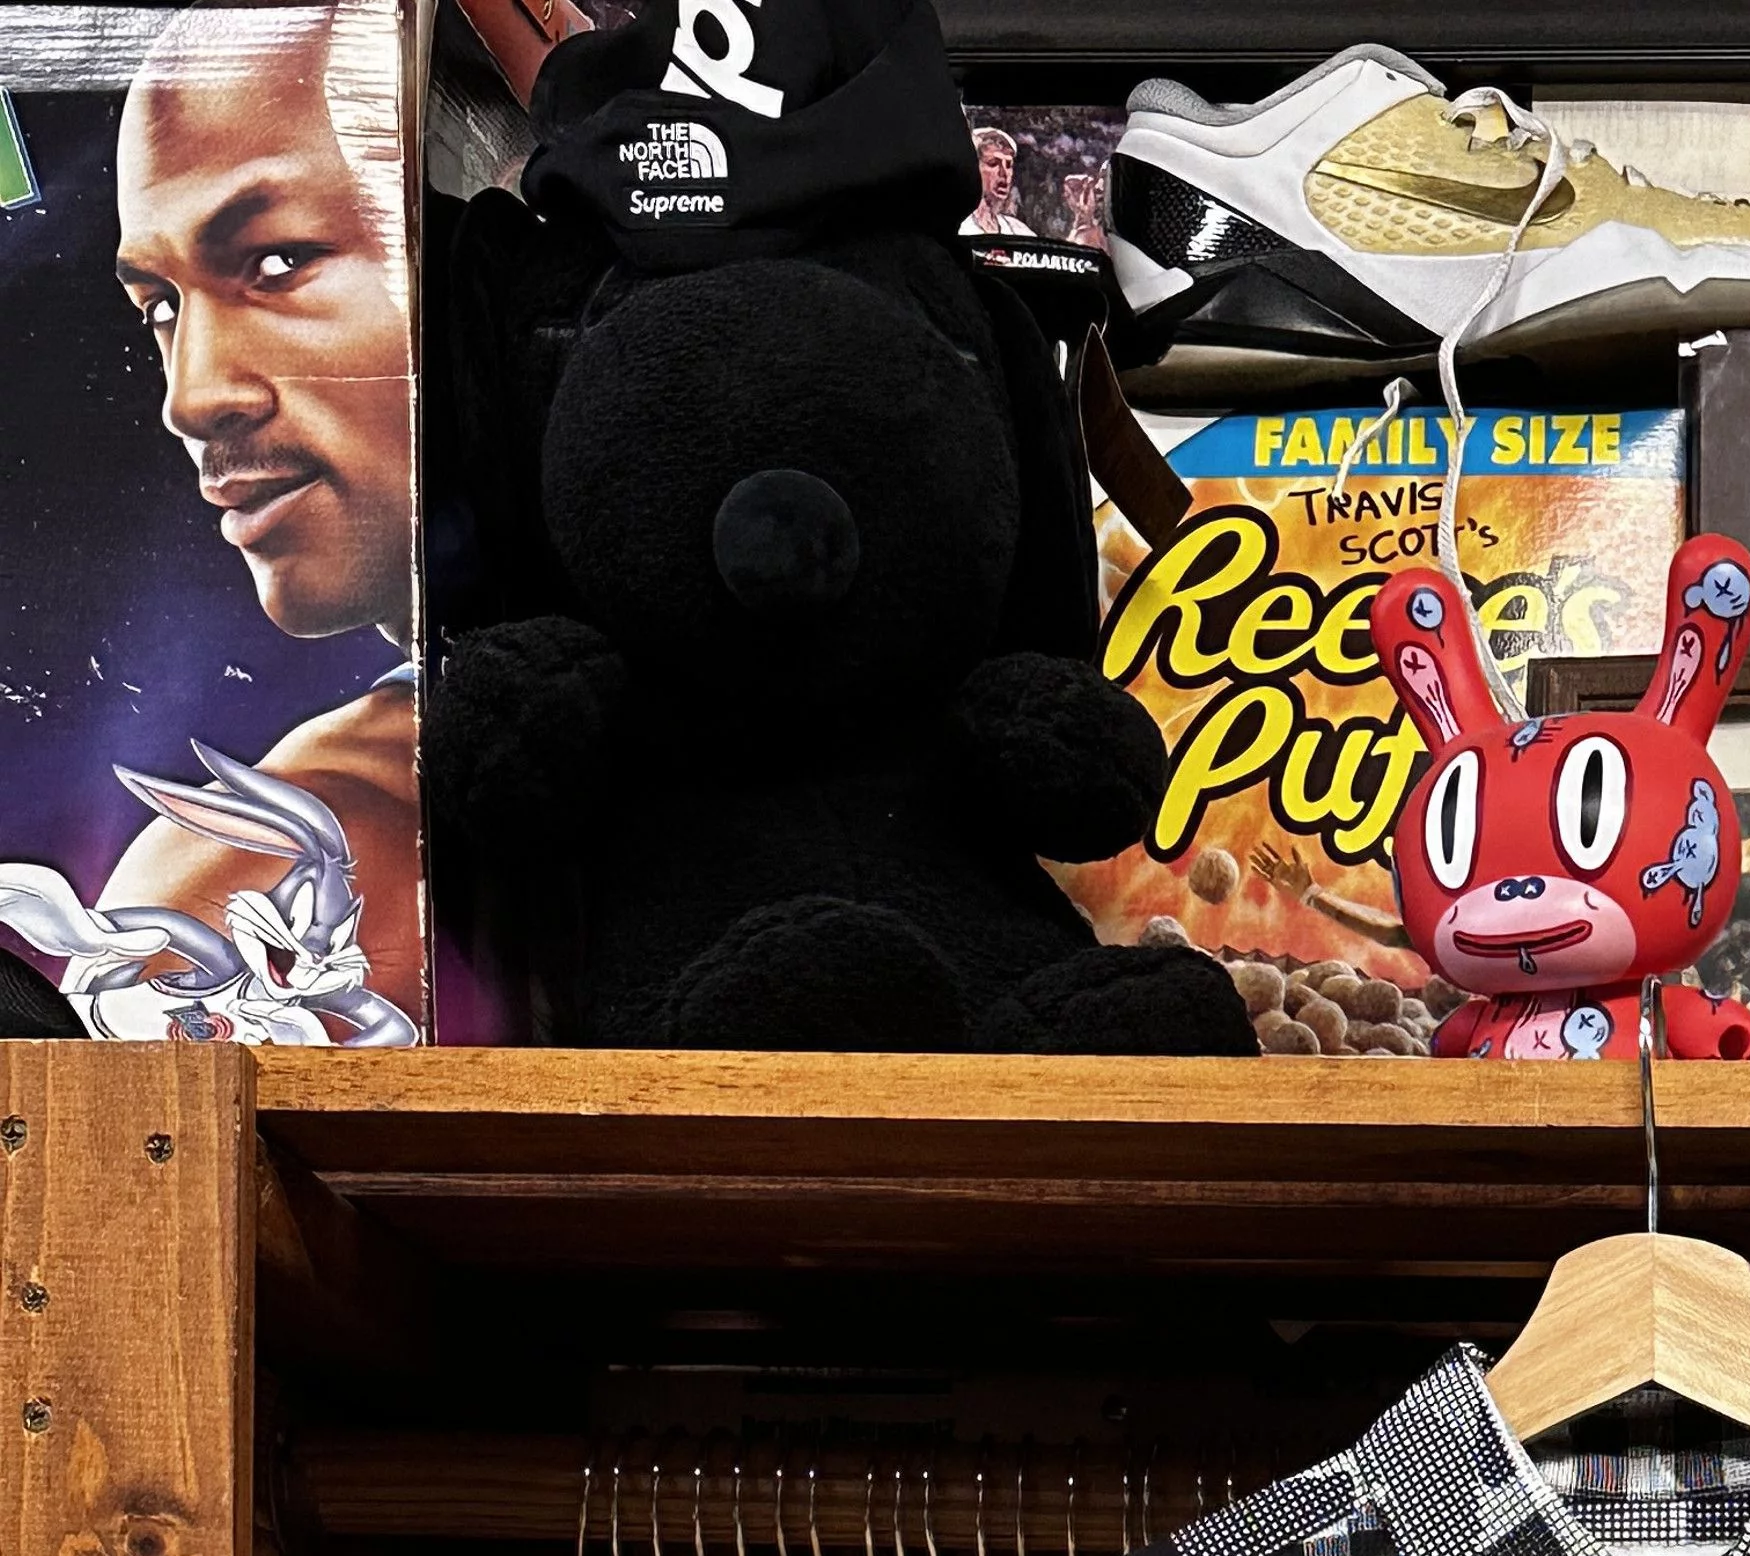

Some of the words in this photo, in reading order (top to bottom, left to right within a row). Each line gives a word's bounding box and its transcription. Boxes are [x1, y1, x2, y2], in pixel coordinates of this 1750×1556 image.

[647, 123, 689, 141] THE
[619, 142, 689, 162] NORTH
[637, 161, 690, 181] FACE
[630, 190, 724, 219] Supreme
[1254, 415, 1474, 467] FAMILY
[1490, 414, 1622, 466] SIZE
[1287, 481, 1444, 526] TRAVIS
